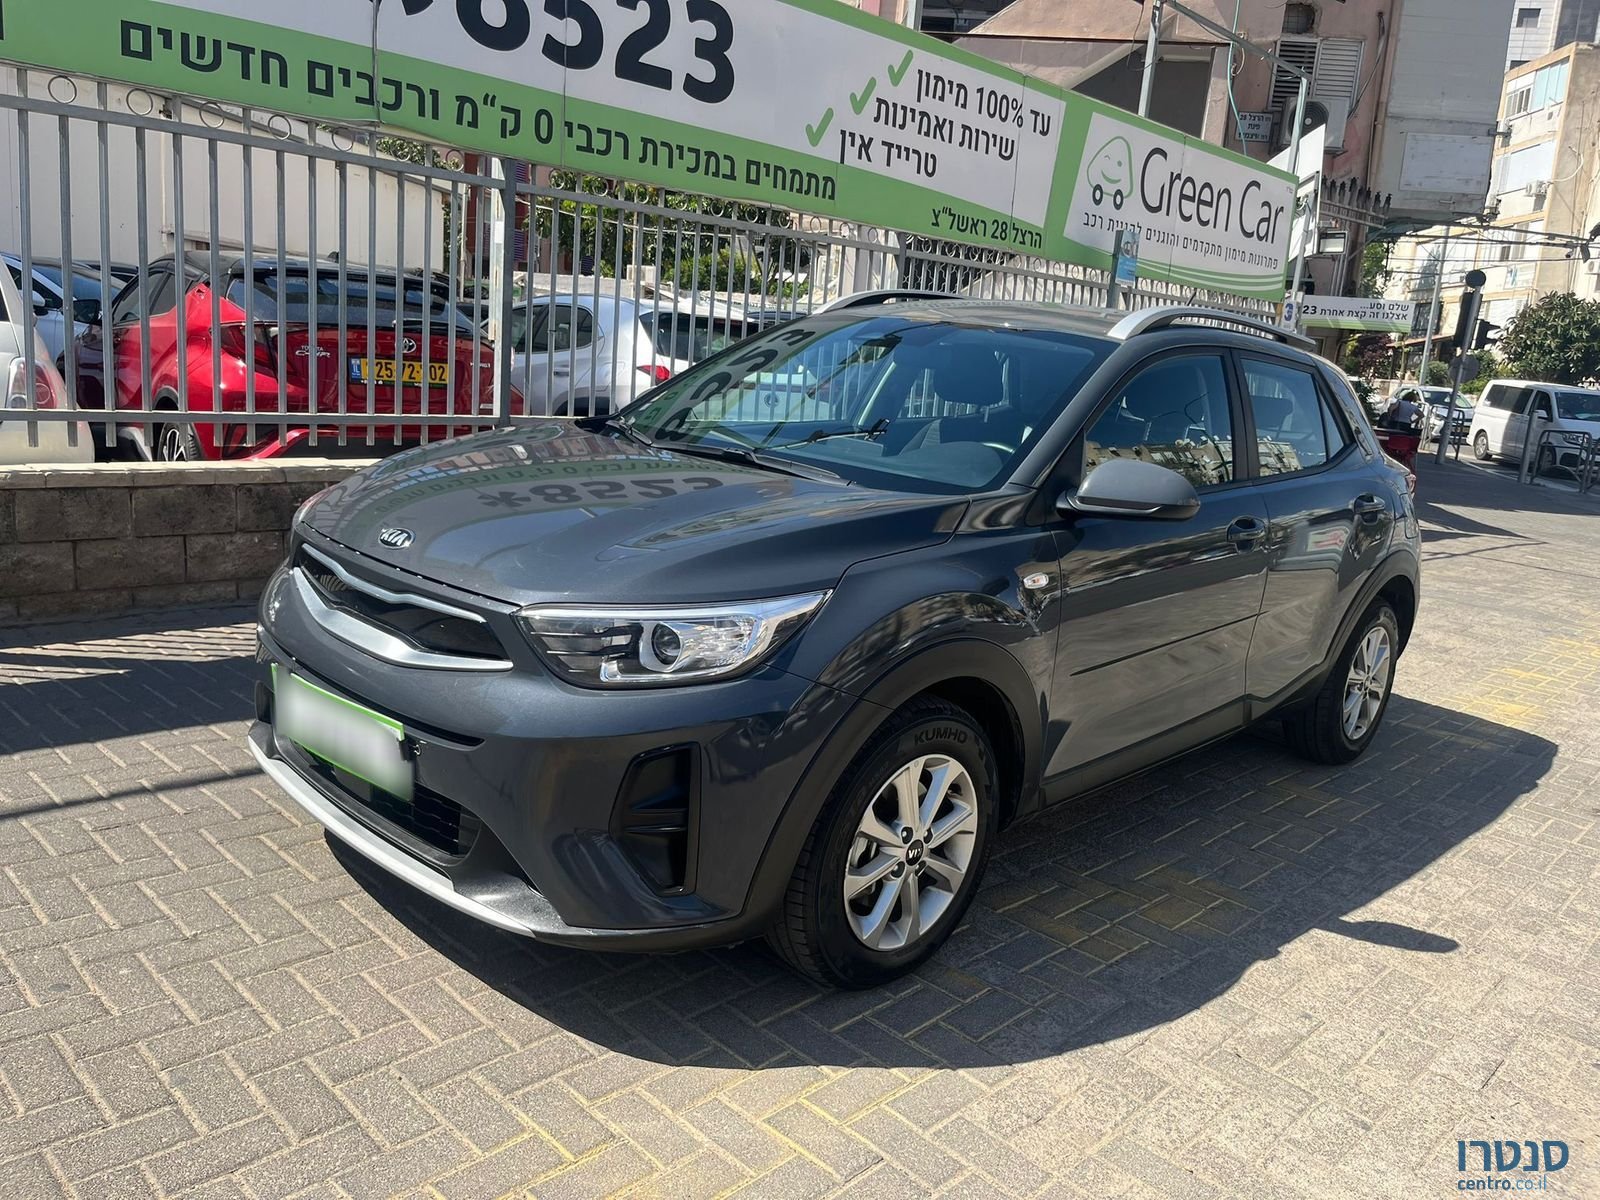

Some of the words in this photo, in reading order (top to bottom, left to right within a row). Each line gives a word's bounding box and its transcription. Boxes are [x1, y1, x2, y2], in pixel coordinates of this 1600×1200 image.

[120, 19, 288, 88] חדשים
[307, 60, 439, 120] ורכבים
[916, 69, 968, 110] מימון
[874, 97, 953, 144] ואמינות
[976, 87, 1024, 128] 100%
[534, 108, 553, 144] 0
[1030, 109, 1051, 137] עד
[564, 121, 629, 160] רכבי
[840, 130, 874, 164] אין
[959, 124, 1015, 161] שירות
[639, 136, 737, 181] במכירת
[881, 140, 937, 178] טרייד
[746, 159, 836, 200] מתמחים
[1140, 147, 1232, 233] Green
[1239, 180, 1284, 244] Car
[991, 219, 1008, 241] 28
[1083, 212, 1104, 229] רכב
[1012, 222, 1042, 249] הרצל
[1145, 227, 1180, 247] והוגנים
[1182, 236, 1222, 257] מתקדמים
[1225, 246, 1246, 262] מימון
[1248, 252, 1278, 270] פתרונות
[1302, 305, 1317, 315] 23
[1320, 307, 1345, 317] אחרת
[1347, 309, 1366, 319] קצת
[1369, 310, 1379, 319] זה
[1382, 312, 1408, 320] אצלנו
[1388, 303, 1409, 312] שלם
[380, 529, 408, 546] KIA
[914, 727, 968, 745] KUMHO
